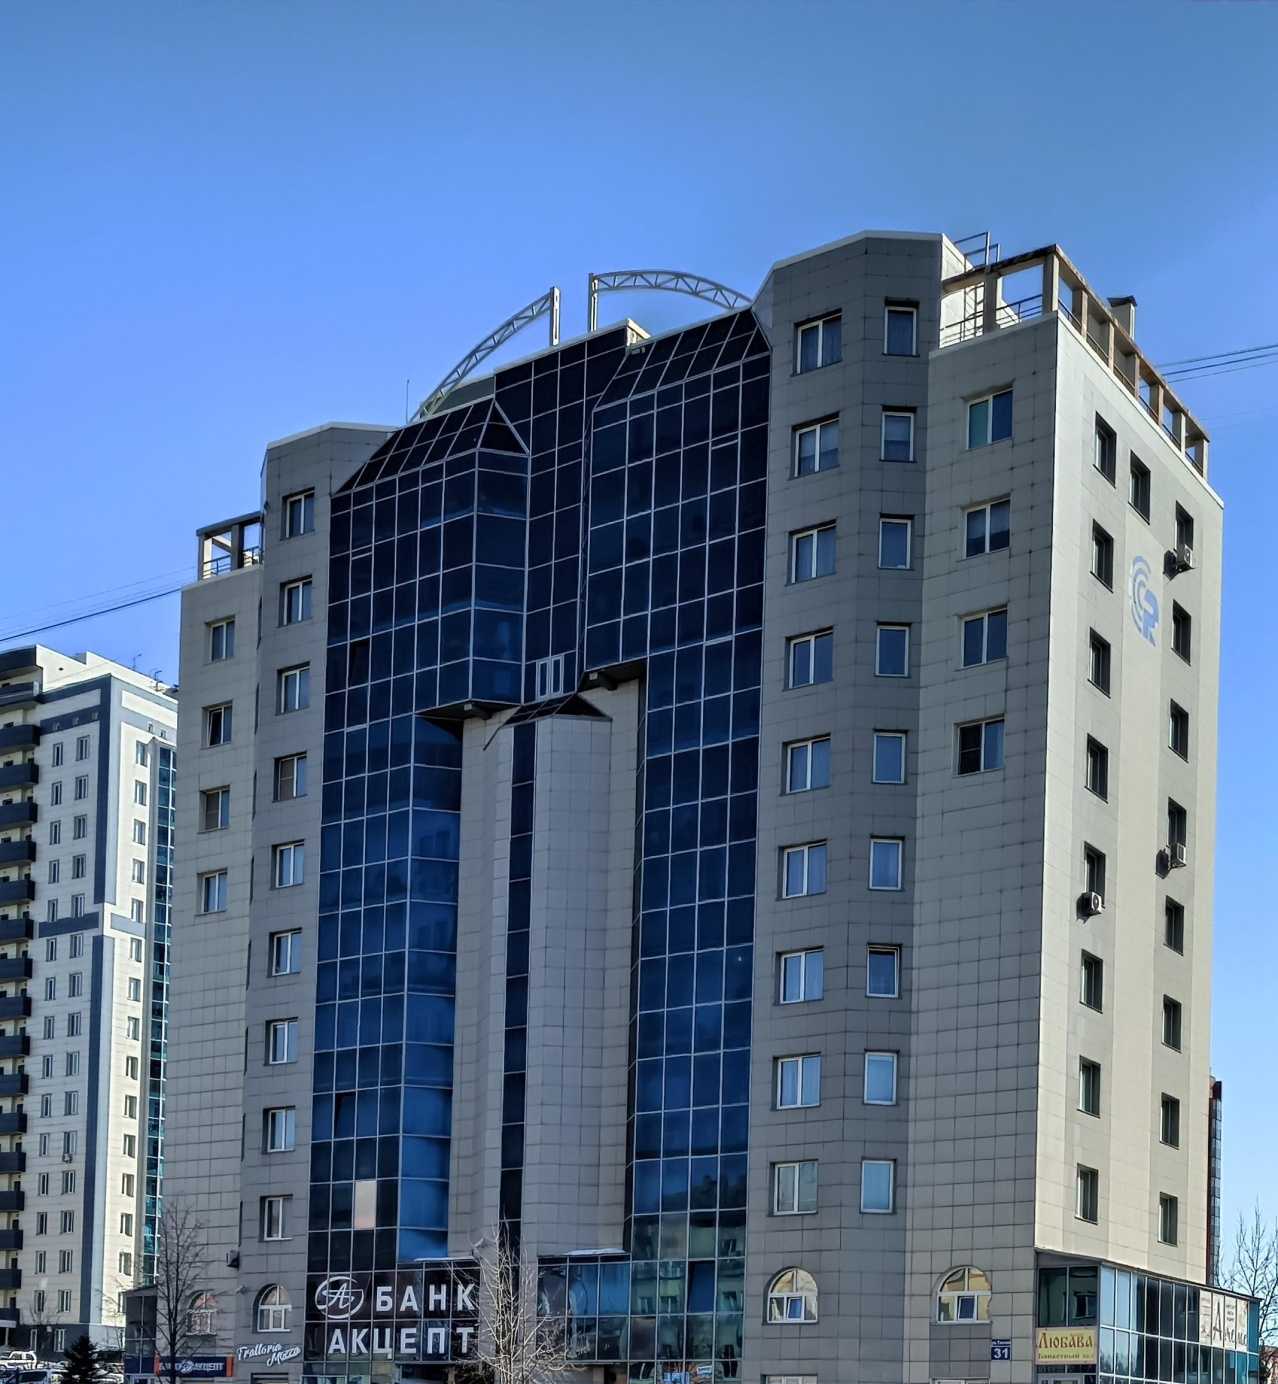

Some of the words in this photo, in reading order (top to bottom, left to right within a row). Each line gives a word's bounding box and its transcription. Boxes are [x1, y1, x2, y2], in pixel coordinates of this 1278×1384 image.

[376, 1284, 475, 1312] БАНК
[328, 1327, 474, 1359] АКЦЕПТ
[994, 1347, 1008, 1359] 31
